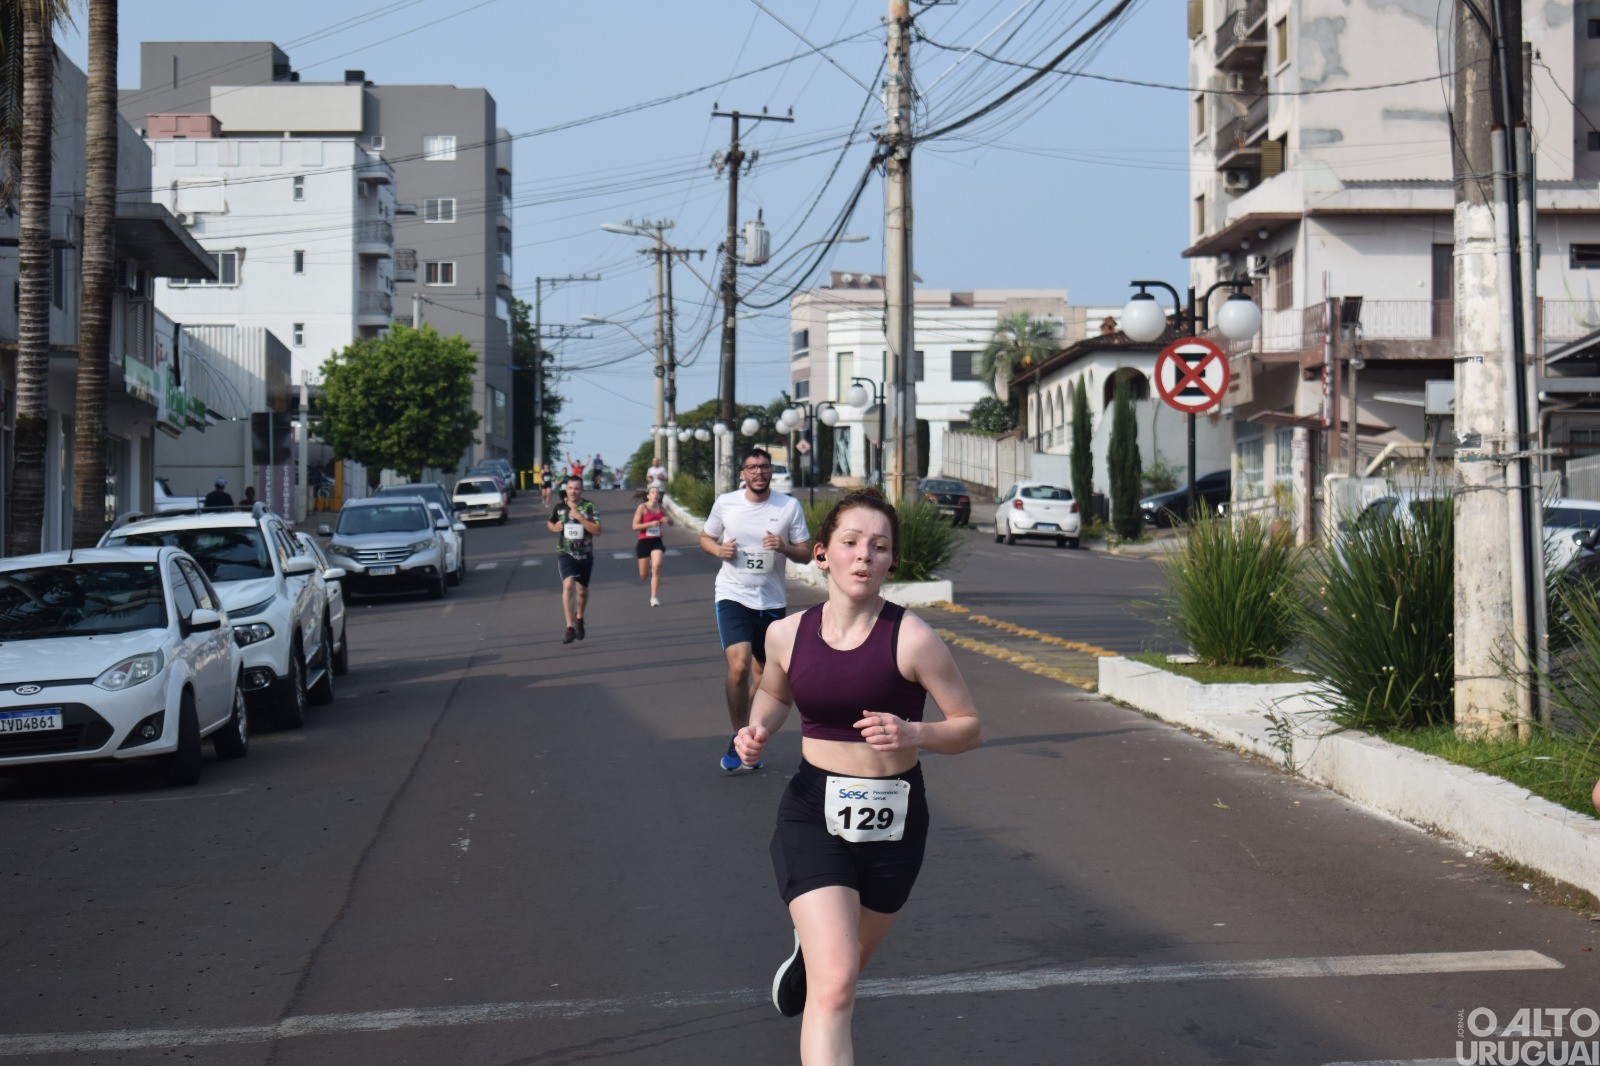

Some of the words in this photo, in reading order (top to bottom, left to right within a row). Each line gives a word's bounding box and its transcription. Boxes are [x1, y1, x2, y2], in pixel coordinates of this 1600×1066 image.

[746, 559, 764, 570] 52
[0, 715, 55, 732] IVD4B61
[838, 788, 869, 800] Sesc
[837, 806, 894, 831] 129
